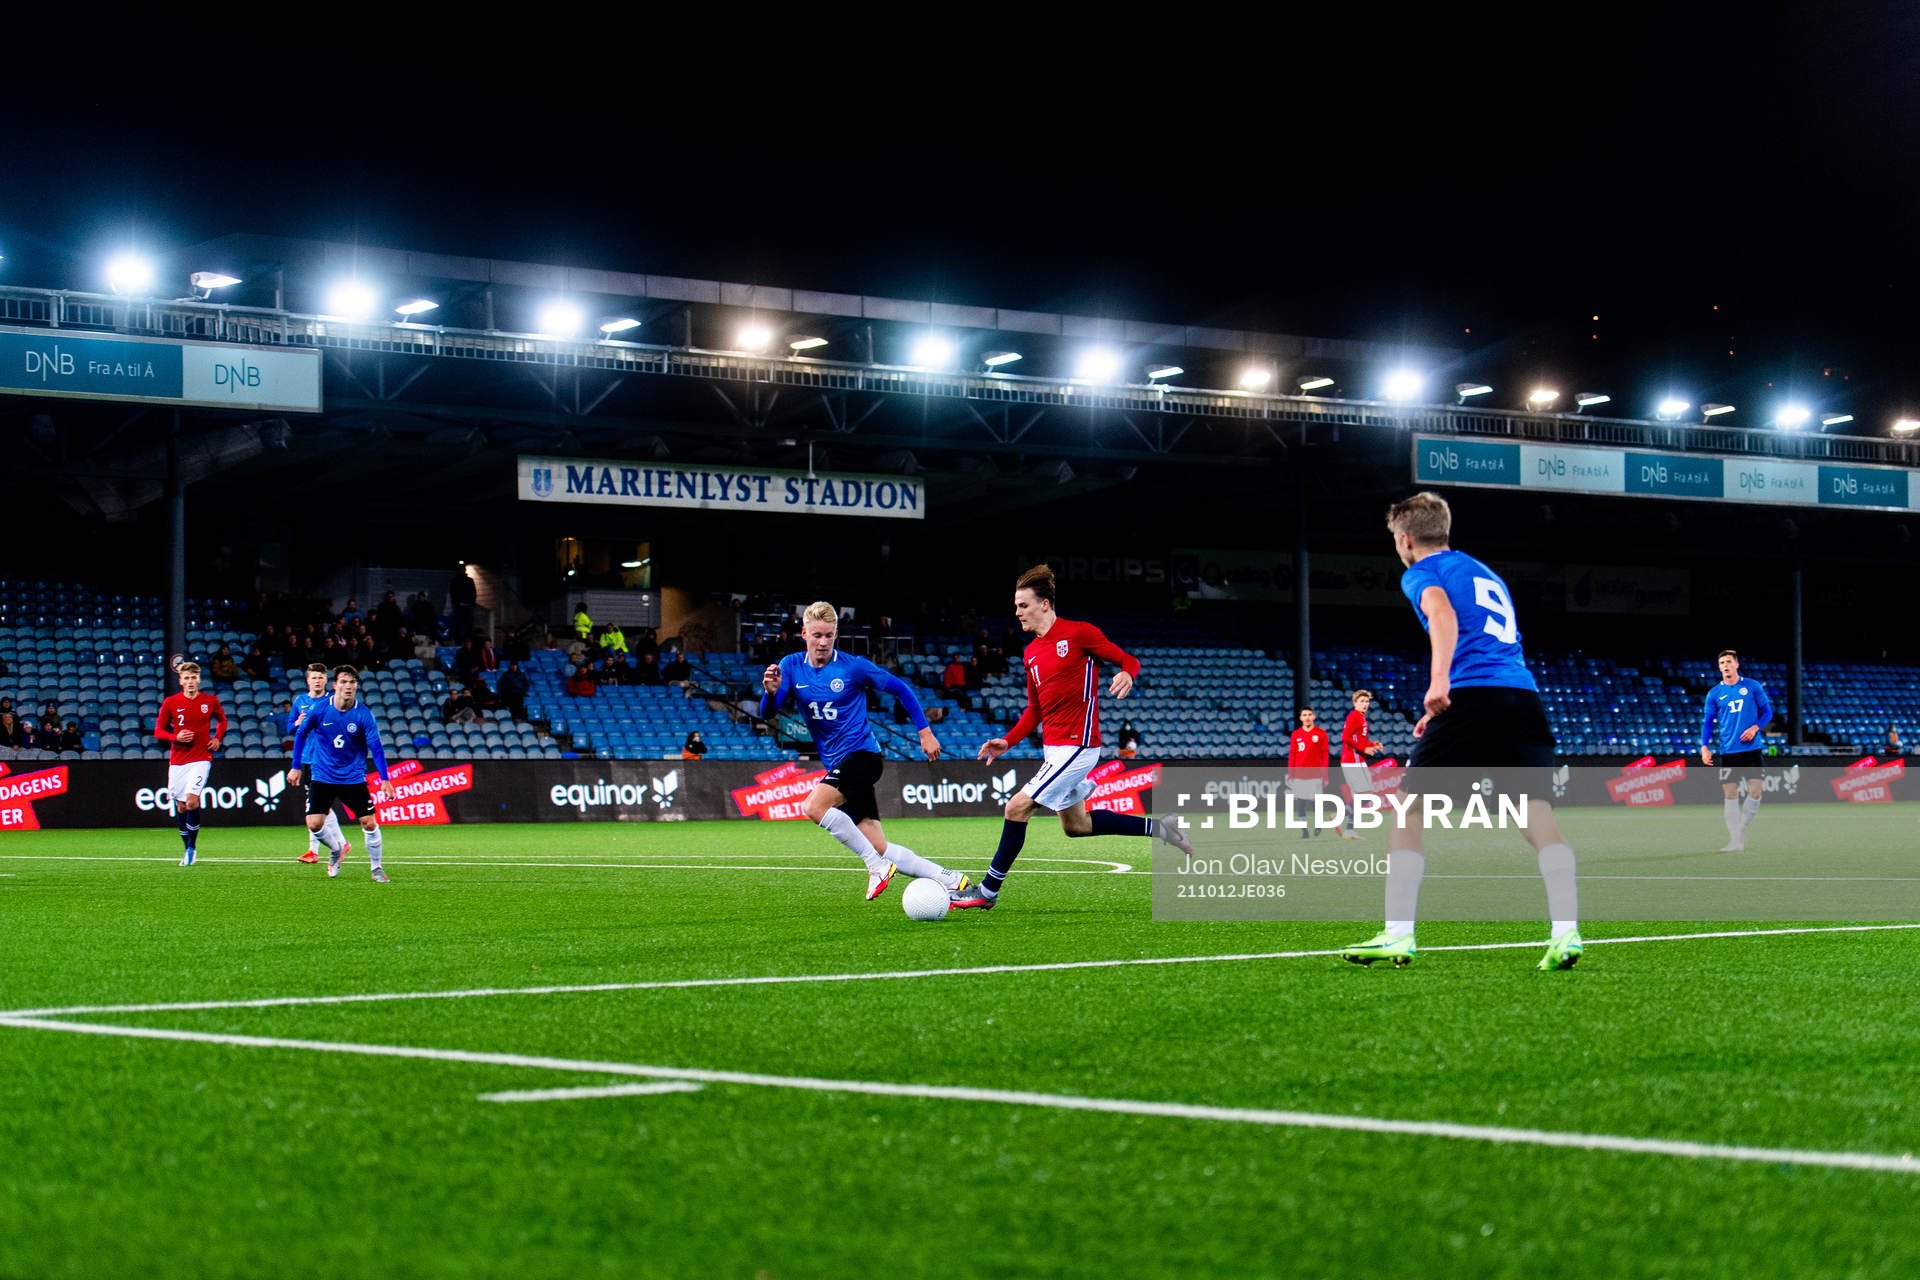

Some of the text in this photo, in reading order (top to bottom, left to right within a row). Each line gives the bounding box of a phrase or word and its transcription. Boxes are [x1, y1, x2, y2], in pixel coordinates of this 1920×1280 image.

[26, 345, 75, 382] DNB
[88, 361, 110, 375] Fra
[114, 363, 124, 376] A
[144, 362, 155, 378] Å
[215, 358, 261, 393] DNB
[1429, 447, 1460, 475] DNB
[1465, 457, 1480, 469] Fra
[1480, 459, 1487, 470] A
[1538, 455, 1566, 480] DNB
[566, 465, 917, 510] MARIENLYST STADION
[1641, 462, 1668, 488] DNB
[1739, 469, 1765, 493] DNB
[1833, 473, 1858, 498] DNB
[1473, 576, 1517, 644] 9
[808, 701, 838, 721] 16
[1728, 699, 1744, 713] 17
[177, 714, 185, 726] 2
[333, 734, 345, 749] 6
[195, 775, 203, 787] 2
[135, 786, 249, 817] eqnor
[550, 778, 648, 813] equinor
[902, 778, 988, 811] equinor
[380, 802, 435, 822] HELTER
